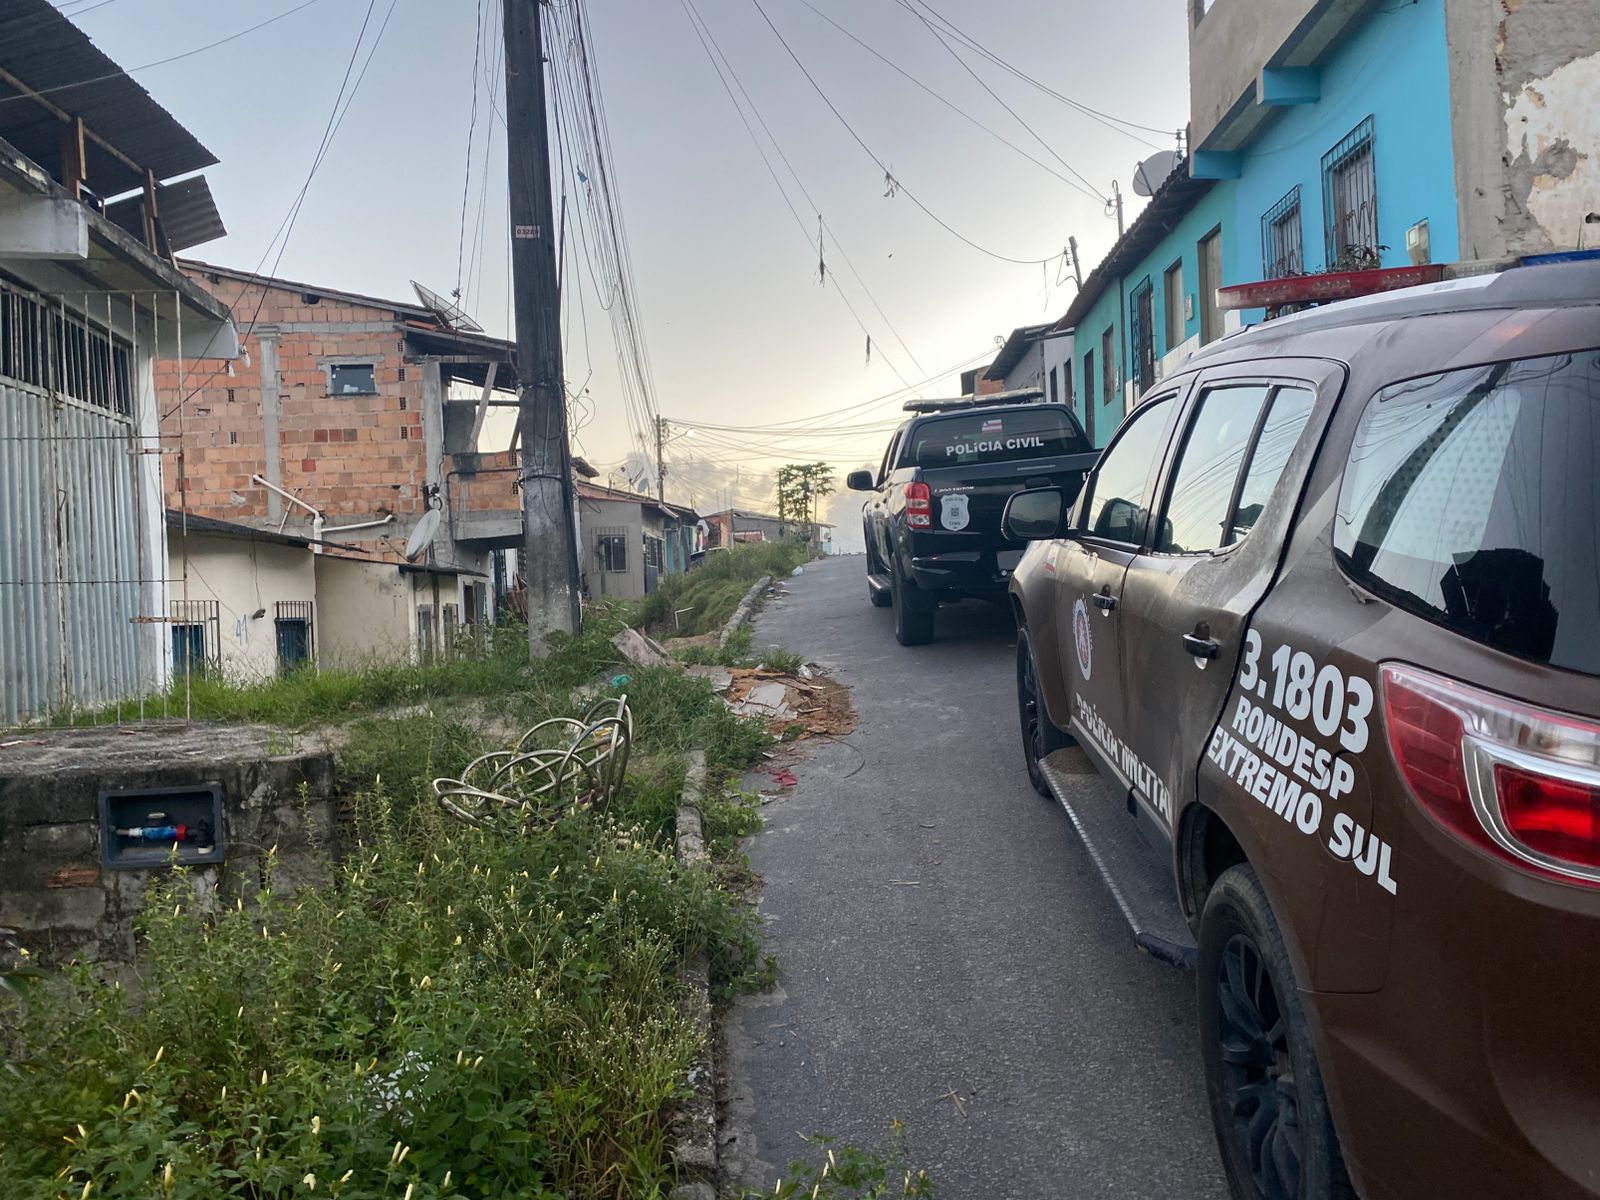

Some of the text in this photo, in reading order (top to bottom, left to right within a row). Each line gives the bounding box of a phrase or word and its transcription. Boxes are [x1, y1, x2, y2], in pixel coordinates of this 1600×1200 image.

[945, 436, 1044, 456] POLÍCIA CIVIL
[1239, 628, 1373, 753] 3.1803
[1118, 738, 1173, 828] MILITA
[1232, 696, 1354, 800] RONDESP
[1206, 725, 1397, 896] EXTREMO SUL
